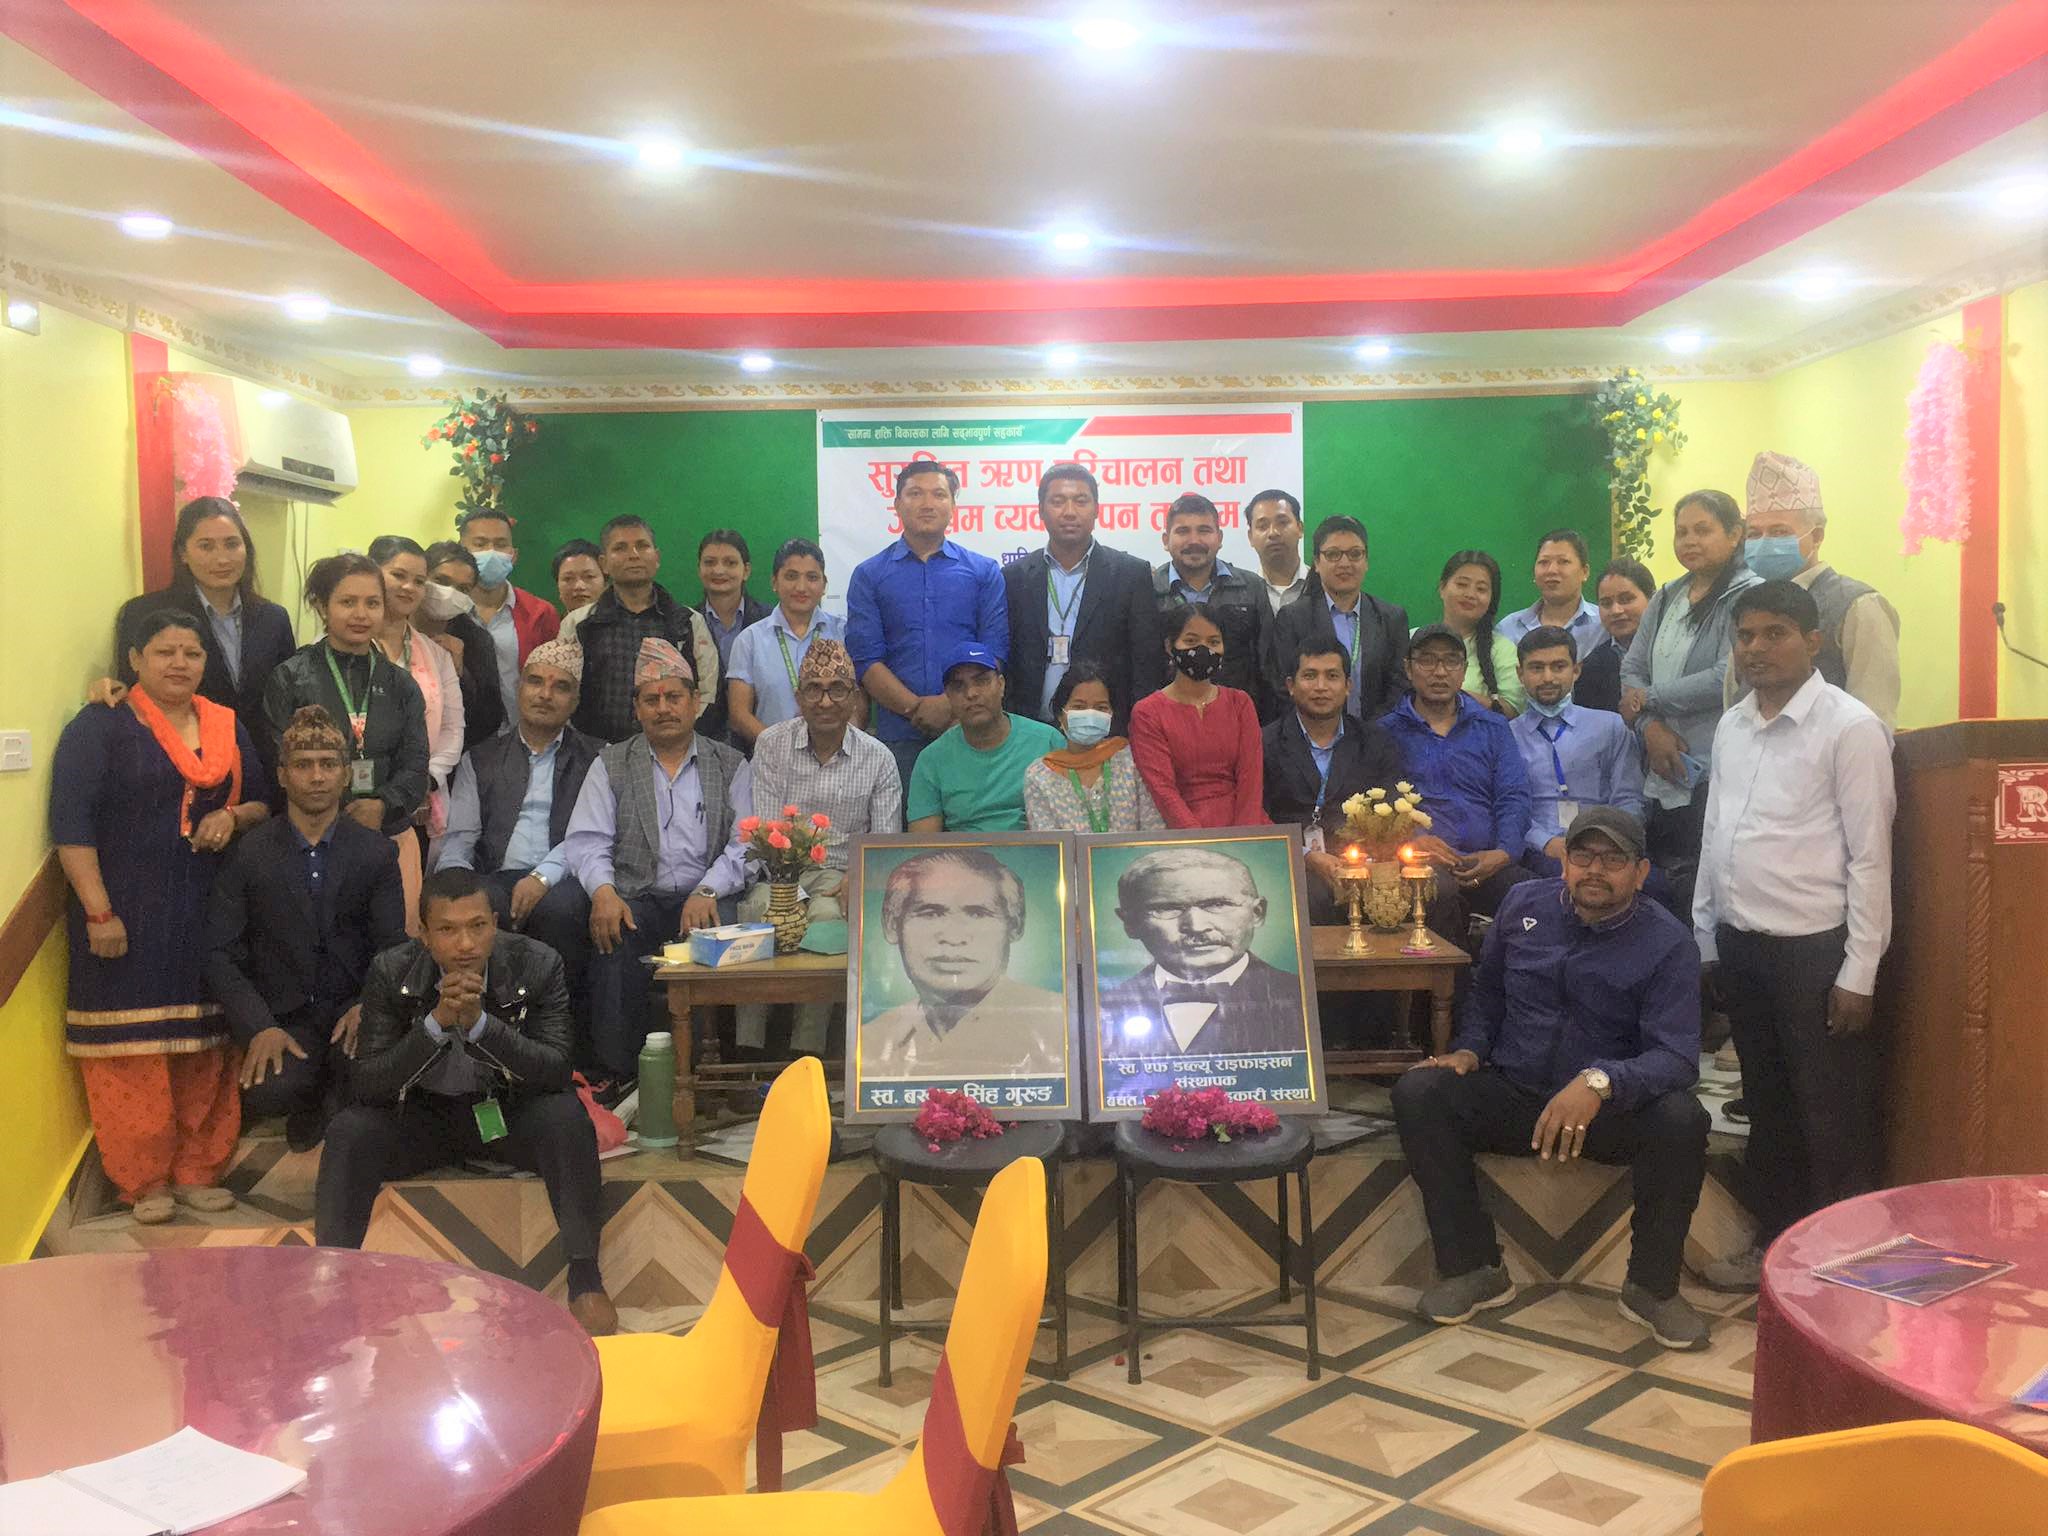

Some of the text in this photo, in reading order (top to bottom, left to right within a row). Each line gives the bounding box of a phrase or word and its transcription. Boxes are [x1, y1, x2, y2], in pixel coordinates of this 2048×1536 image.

[1193, 456, 1248, 486] तथा
[1144, 1062, 1169, 1073] एफ
[870, 1089, 898, 1106] स्व.
[1271, 1087, 1310, 1101] संस्था
